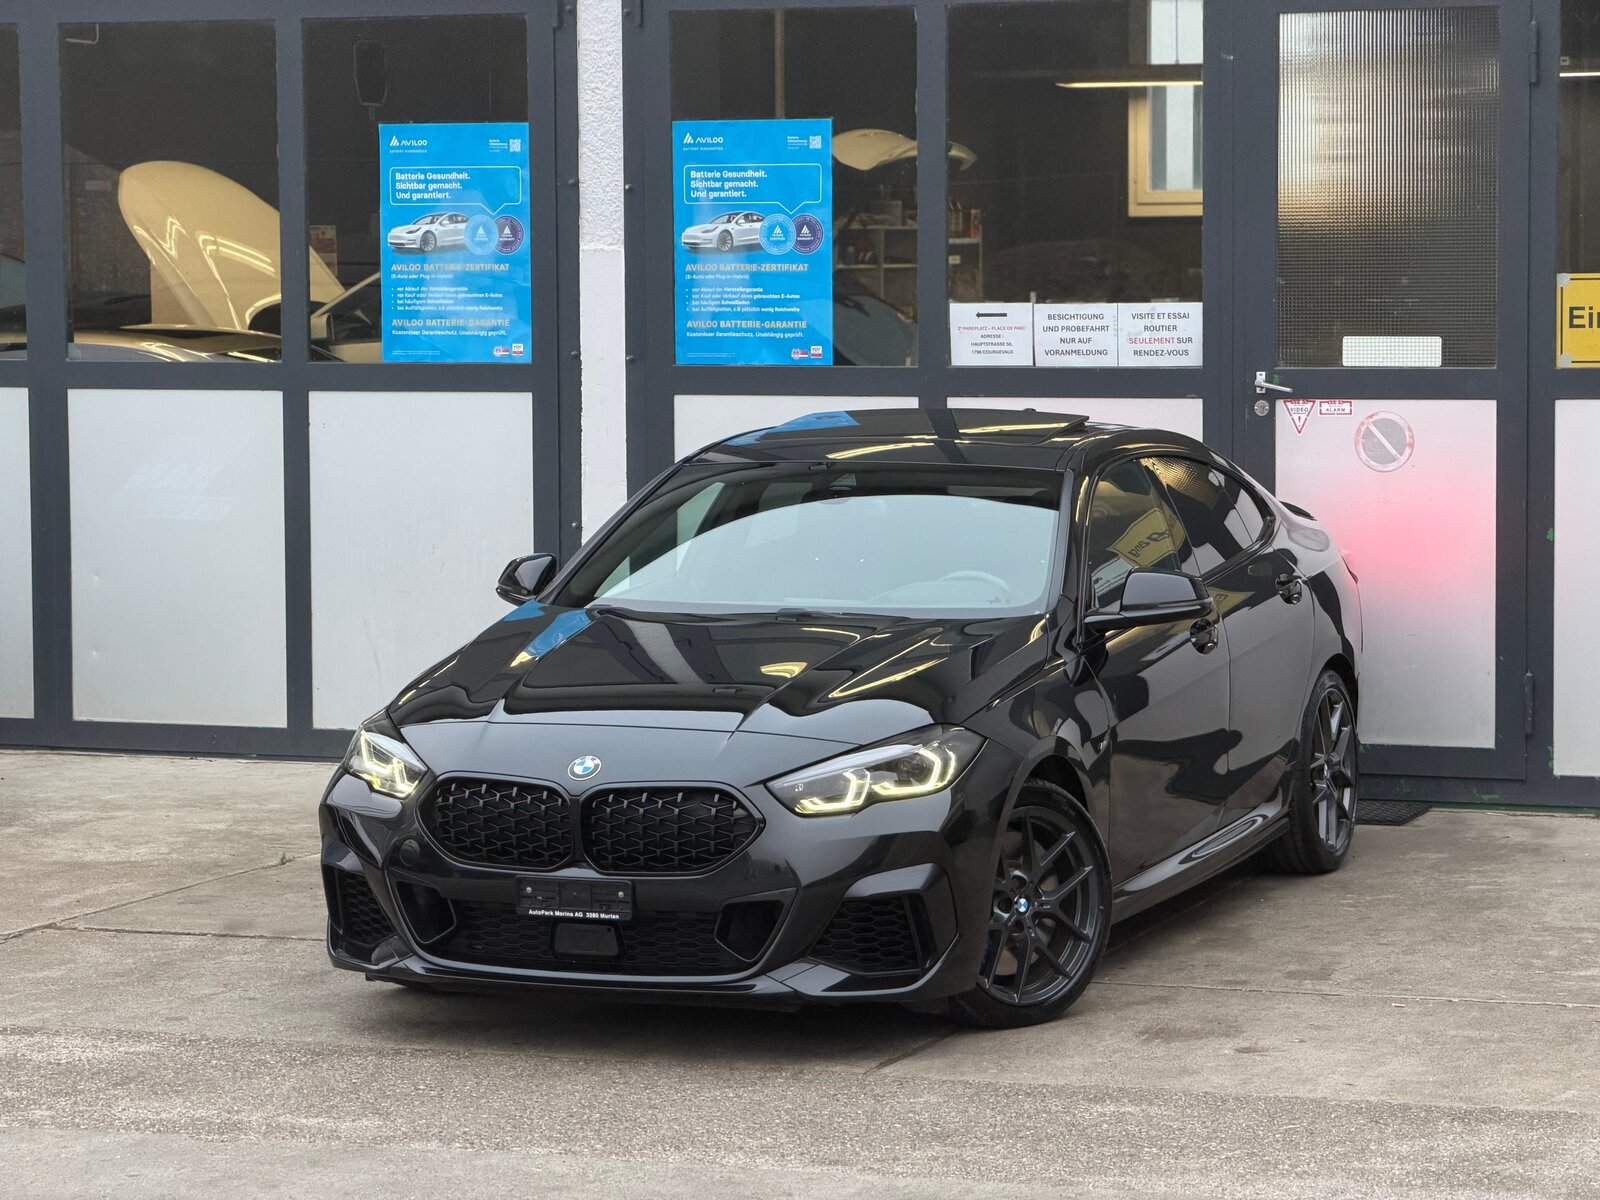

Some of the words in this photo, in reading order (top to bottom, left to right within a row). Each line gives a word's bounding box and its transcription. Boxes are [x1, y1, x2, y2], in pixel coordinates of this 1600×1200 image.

[396, 172, 425, 180] Batterie
[426, 172, 470, 180] Gesundheit.
[690, 170, 721, 178] Batterie
[722, 170, 768, 178] Gesundheit.
[428, 182, 462, 191] gemacht.
[690, 180, 722, 188] Sichtbar
[724, 180, 759, 189] gemacht.
[412, 192, 451, 201] garantiert.
[691, 190, 706, 198] Und
[708, 190, 747, 199] garantiert.
[391, 263, 421, 271] AVILOO
[685, 263, 718, 271] AVILOO
[720, 263, 809, 271] BATTERIE-ZERTIFIKAT
[1047, 313, 1105, 321] BESICHTIGUNG
[1131, 312, 1156, 320] VISITE
[1569, 306, 1600, 329] Ei
[392, 319, 424, 327] AVILOO
[686, 320, 718, 328] AVILOO
[720, 320, 807, 328] BATTERIE-GARANTIE
[1128, 337, 1175, 345] SEULEMENT
[1133, 349, 1190, 357] RENDEZ-VOUS
